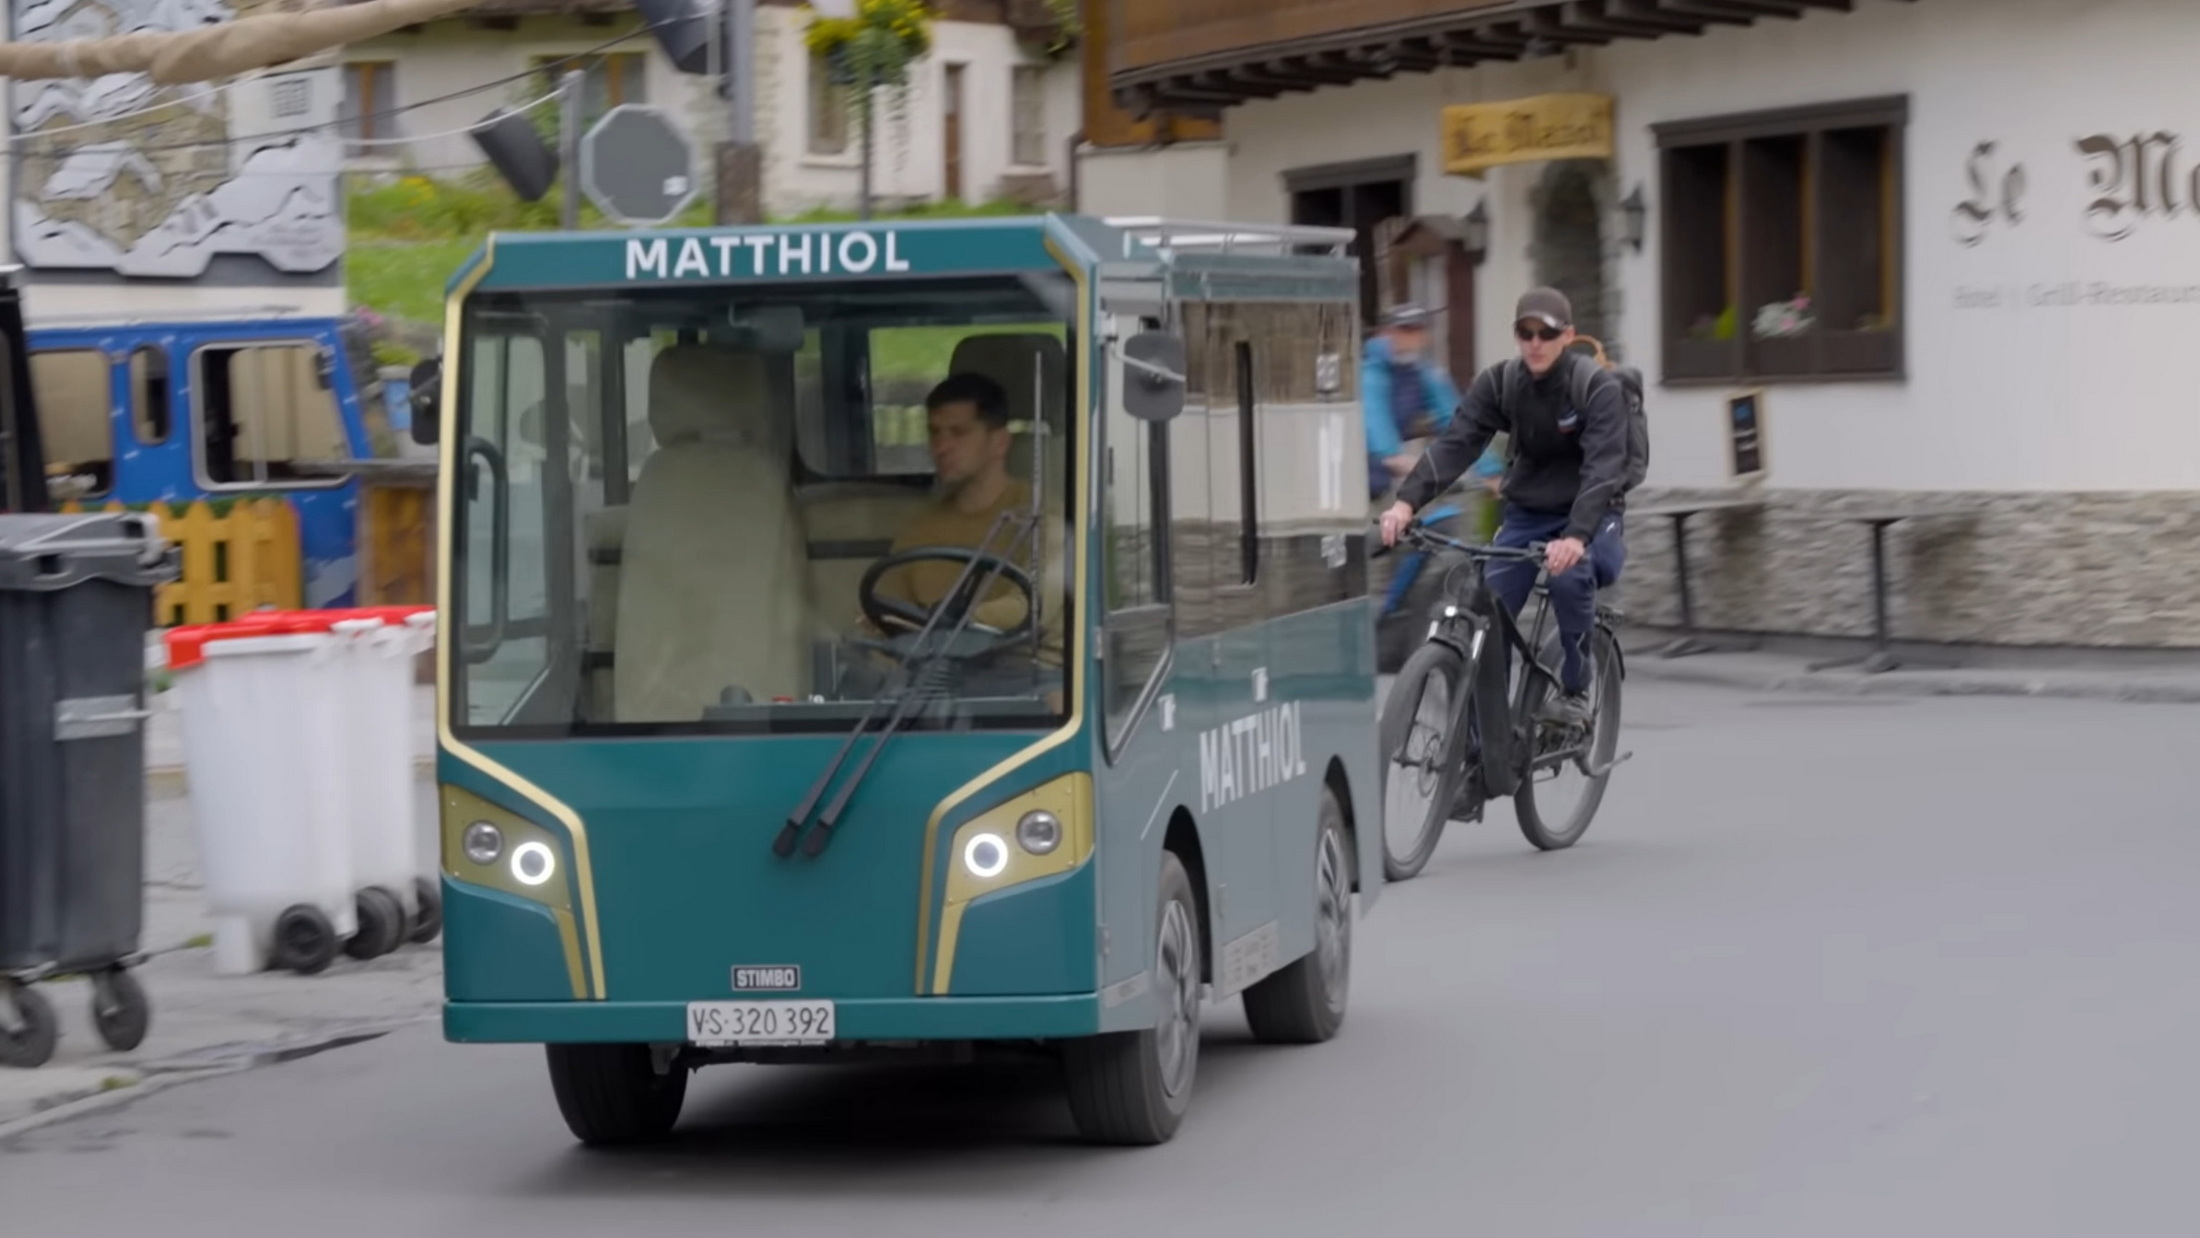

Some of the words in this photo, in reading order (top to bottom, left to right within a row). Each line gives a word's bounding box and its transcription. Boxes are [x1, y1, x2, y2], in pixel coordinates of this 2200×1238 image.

[1952, 139, 2026, 247] Le
[2076, 130, 2200, 242] M
[626, 230, 909, 279] MATTHIOL
[1200, 699, 1306, 815] MATTHIOL
[736, 968, 796, 987] STIMBO
